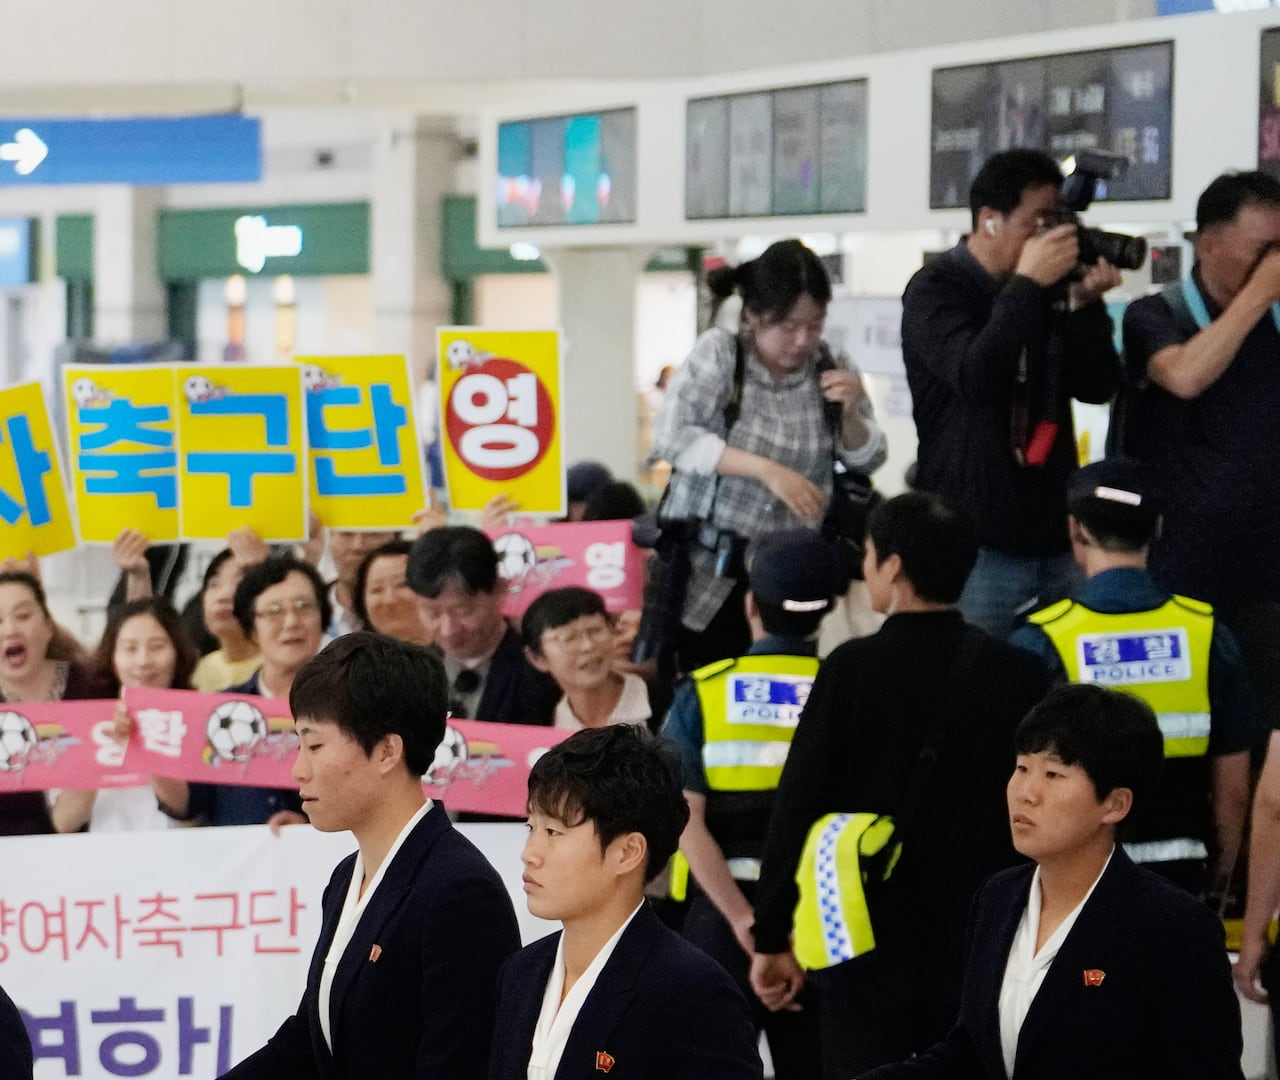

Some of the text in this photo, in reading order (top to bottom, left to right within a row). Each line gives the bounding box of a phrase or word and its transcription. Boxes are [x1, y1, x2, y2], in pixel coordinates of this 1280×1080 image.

[78, 397, 178, 510] 축
[186, 393, 298, 507] 구
[306, 383, 409, 496] 단
[451, 372, 539, 469] 영
[584, 541, 627, 590] 영
[742, 705, 807, 721] POLI
[1092, 664, 1174, 680] POLICE
